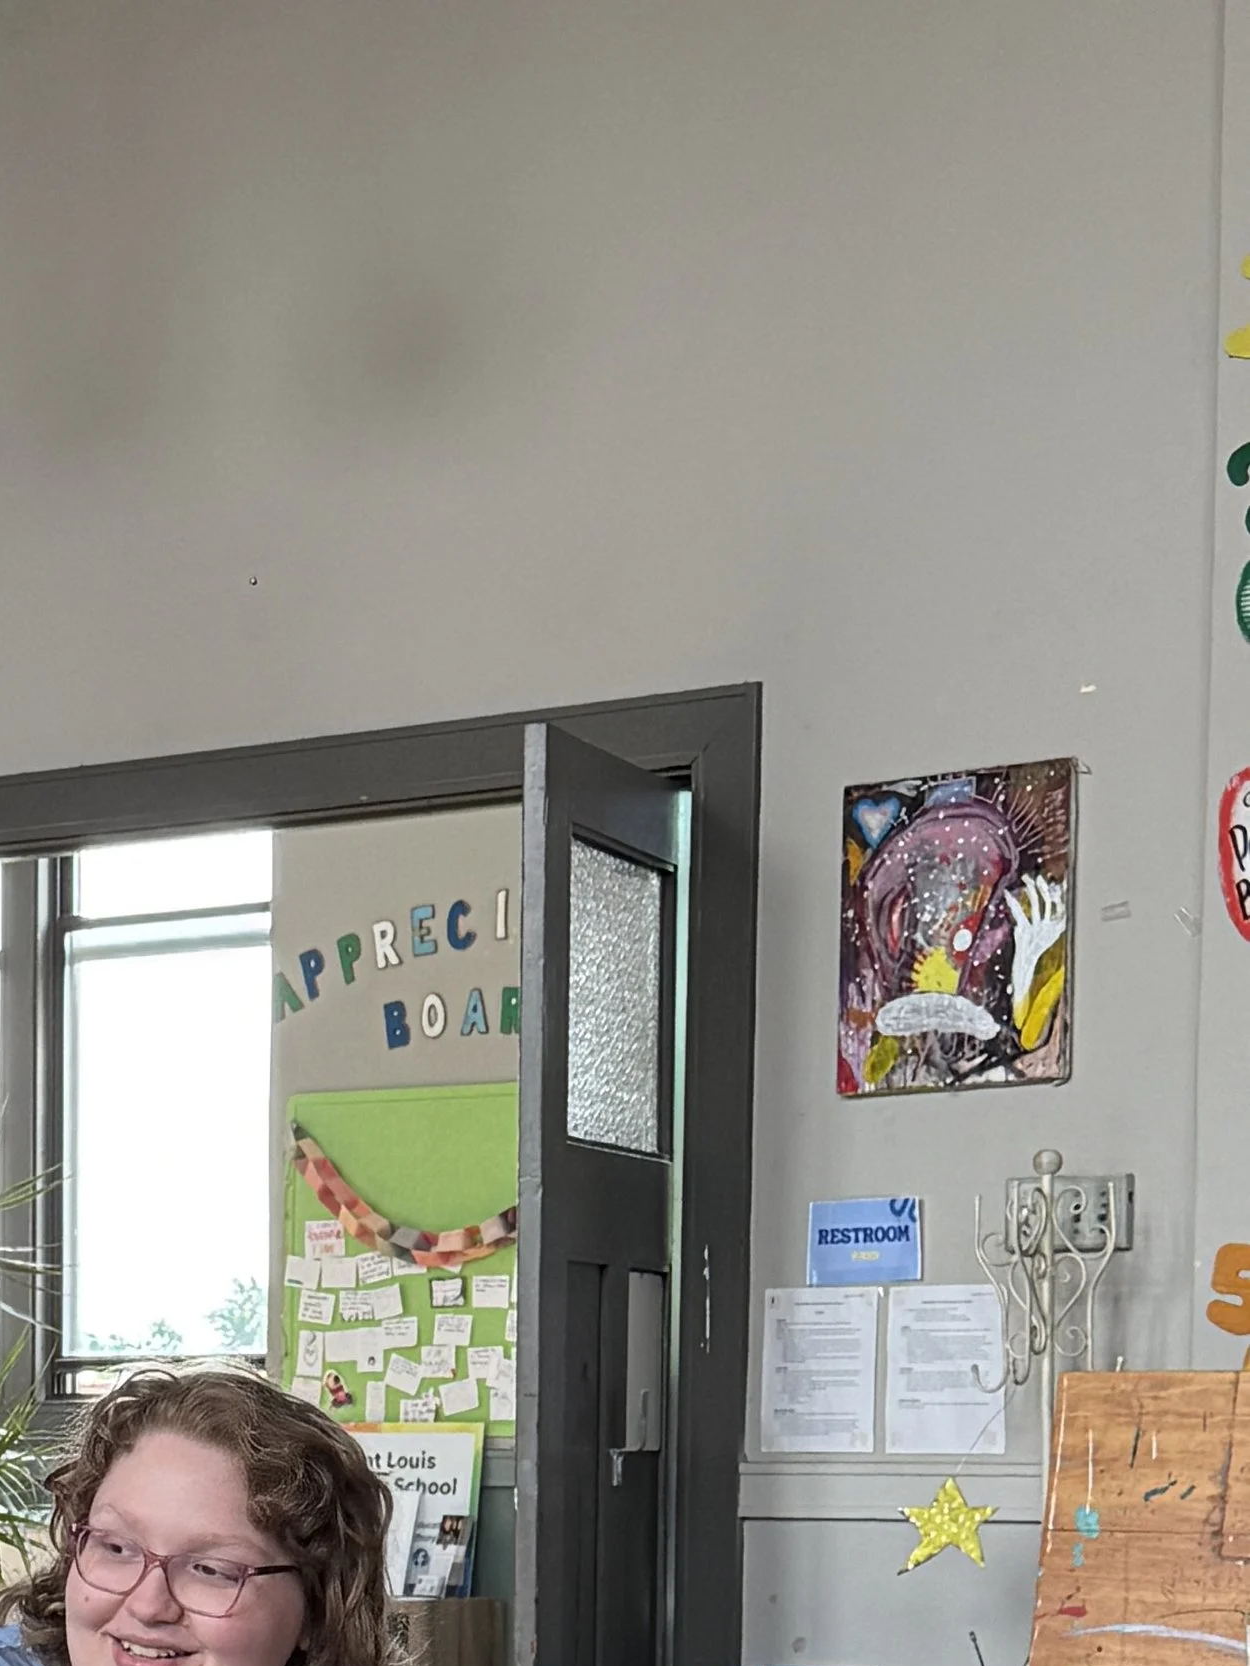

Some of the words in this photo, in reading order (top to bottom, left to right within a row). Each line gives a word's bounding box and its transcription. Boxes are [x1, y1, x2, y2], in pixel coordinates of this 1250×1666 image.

[383, 987, 521, 1050] BOAR
[817, 1225, 911, 1246] RESTROOM
[387, 1450, 437, 1469] Louis
[394, 1477, 457, 1495] School
